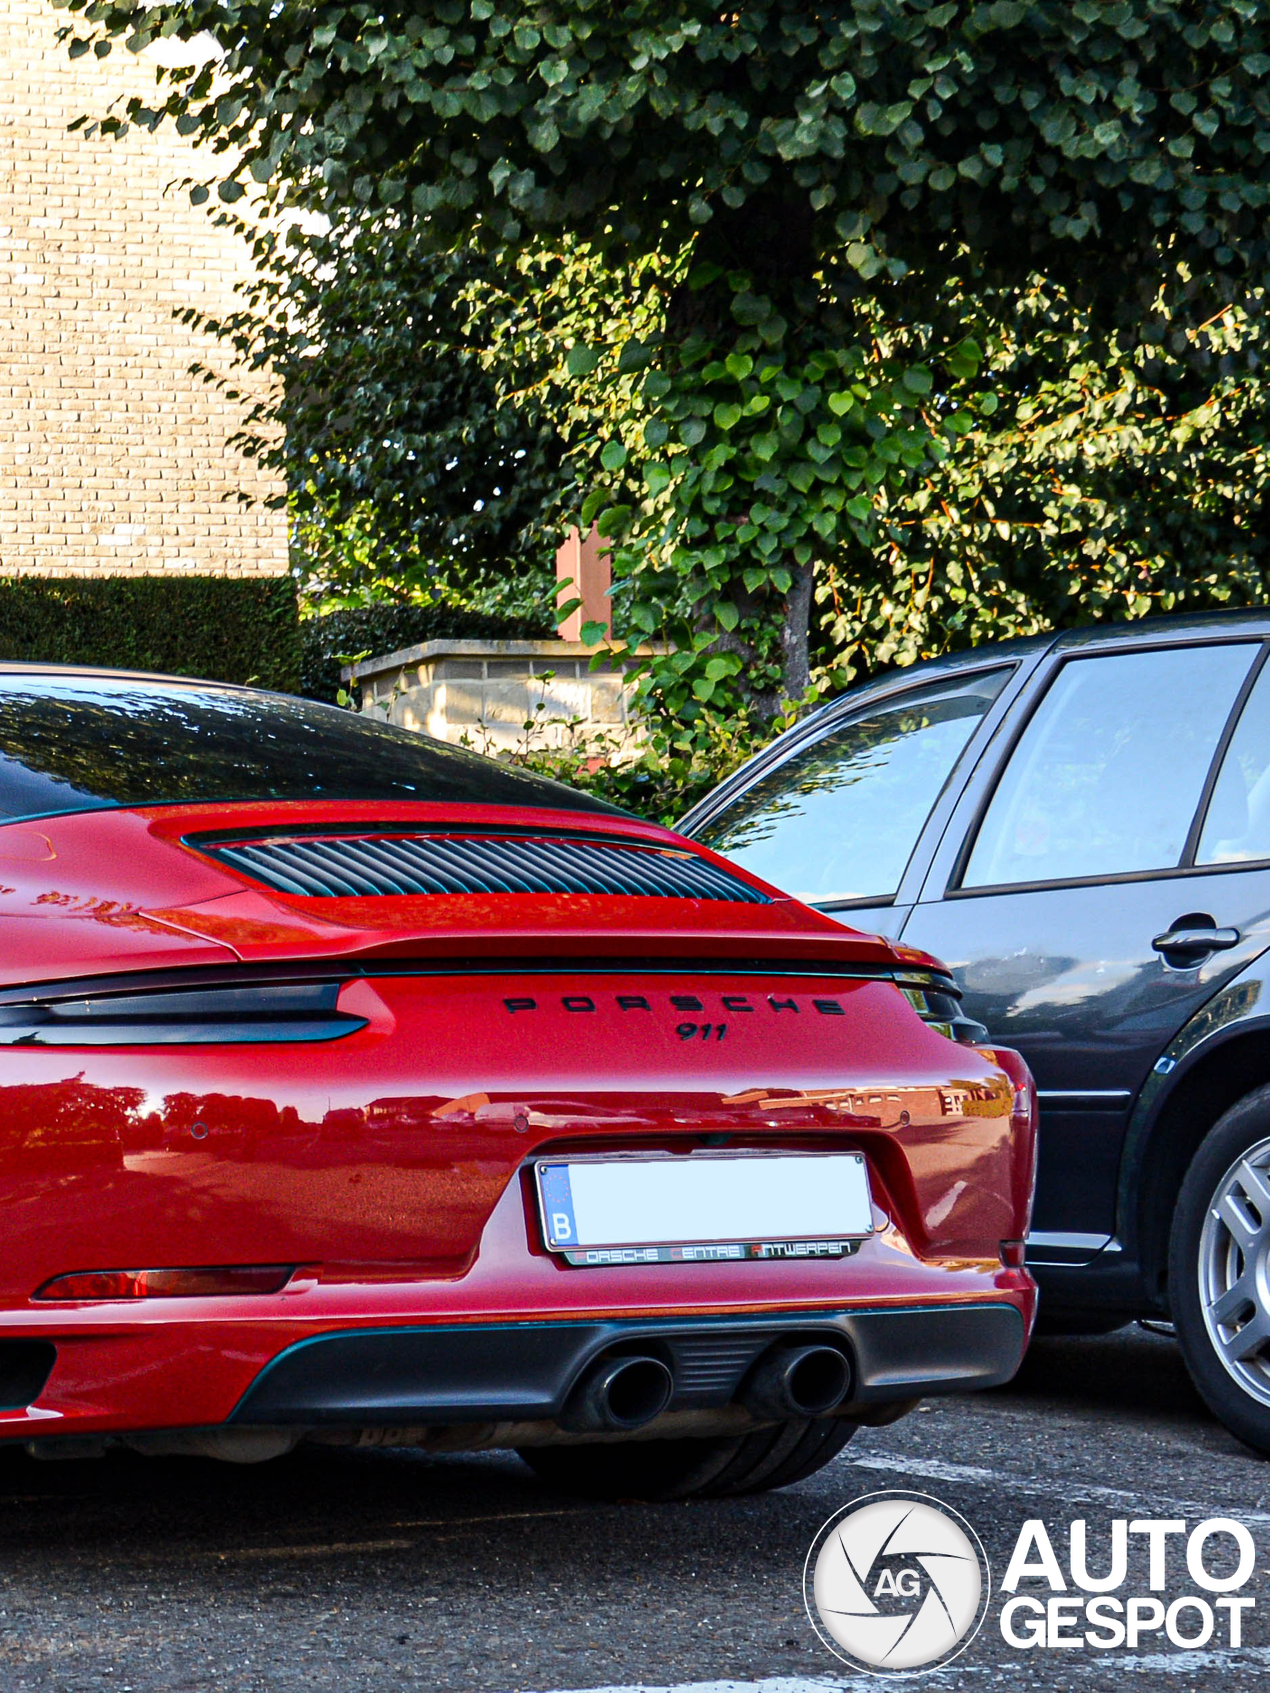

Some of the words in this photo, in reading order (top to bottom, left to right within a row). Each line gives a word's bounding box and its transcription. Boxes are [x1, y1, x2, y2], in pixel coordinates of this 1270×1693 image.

[502, 995, 846, 1015] PORSCHE
[675, 1022, 728, 1041] 911
[552, 1213, 572, 1240] B
[574, 1248, 659, 1263] PORSCHE
[670, 1244, 740, 1259] CENTRE
[751, 1240, 851, 1256] ANTWERPEN
